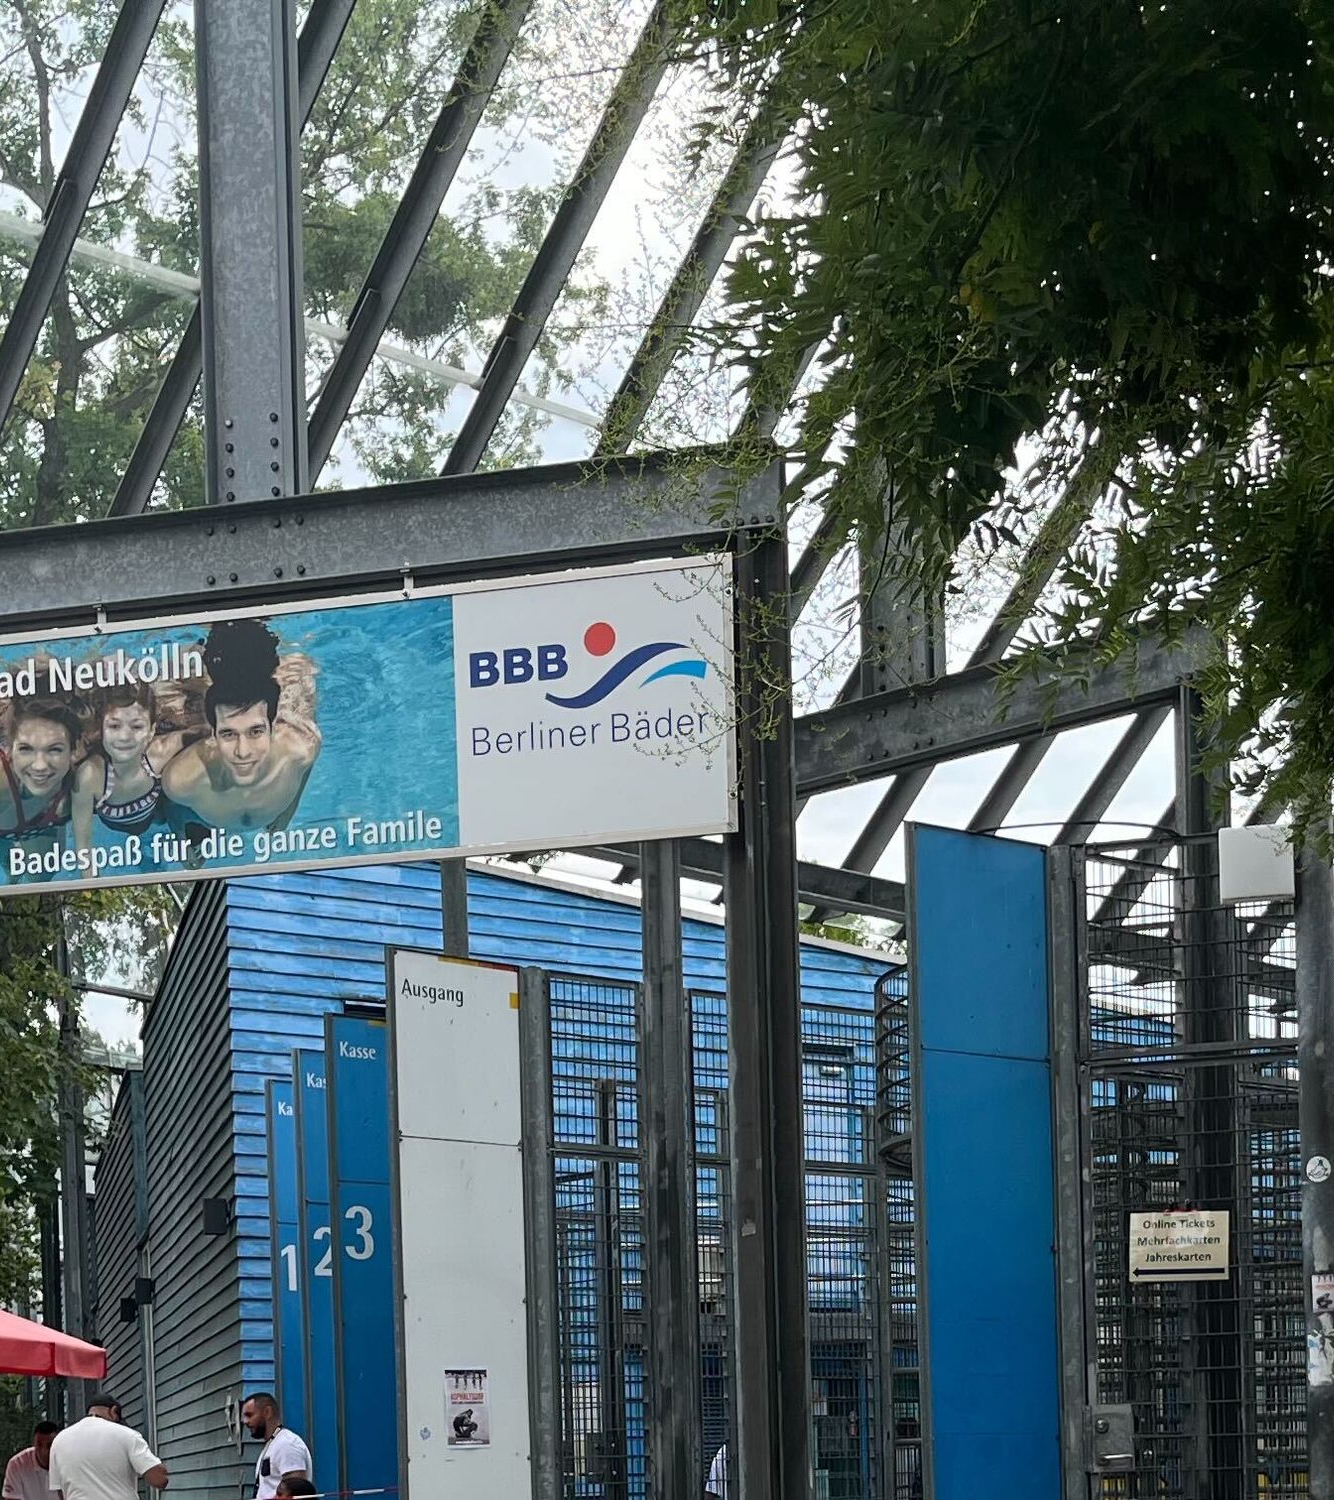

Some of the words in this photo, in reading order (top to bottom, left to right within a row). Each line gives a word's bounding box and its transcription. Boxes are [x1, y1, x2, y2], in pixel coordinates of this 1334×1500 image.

[48, 642, 203, 693] Neukölln
[469, 643, 569, 689] BBB
[471, 720, 602, 757] Berliner
[610, 707, 710, 744] Bäder
[8, 838, 142, 878] Badespaß
[150, 832, 200, 863] für
[201, 828, 244, 860] die
[253, 825, 337, 862] ganze
[347, 809, 443, 846] Famile
[401, 977, 464, 1008] Ausgang
[339, 1040, 377, 1060] Kasse
[344, 1205, 375, 1260] 3
[1137, 1235, 1221, 1246] Mehrfachkarten
[1142, 1219, 1177, 1229] Online
[1179, 1219, 1216, 1228] Tickets
[280, 1243, 298, 1292] 1
[313, 1226, 333, 1277] 2
[1145, 1252, 1212, 1263] Jahreskarten
